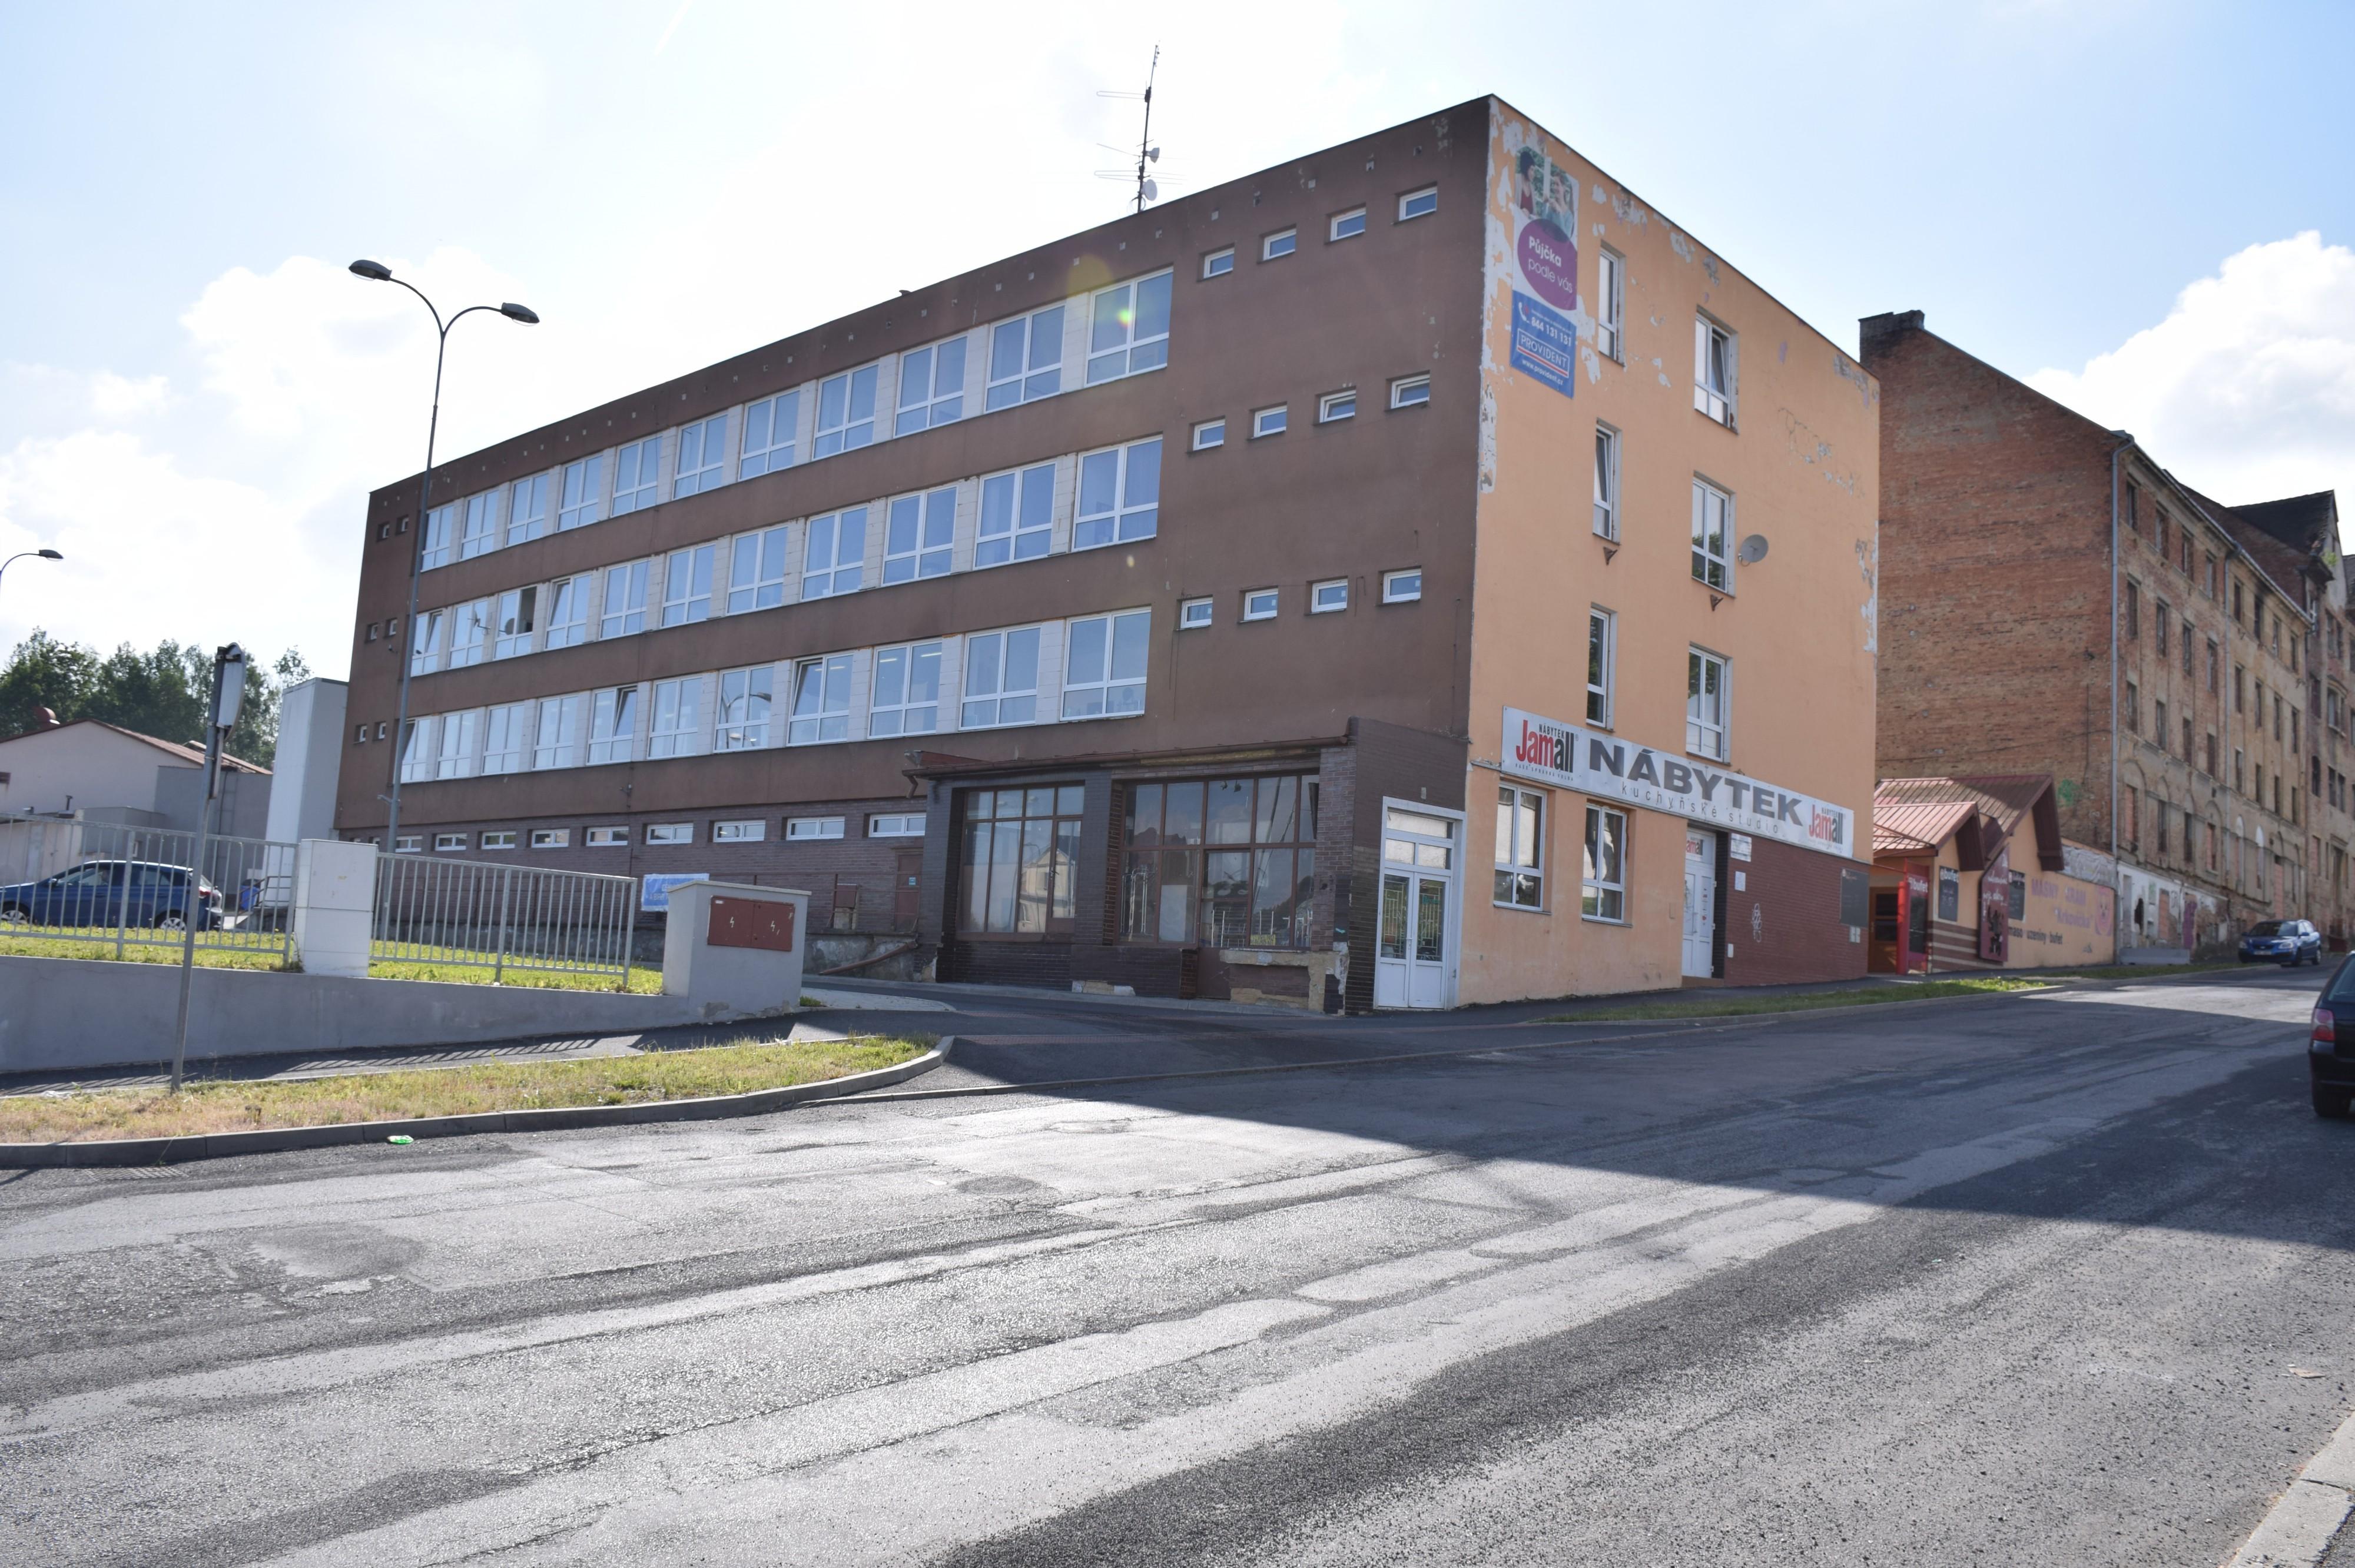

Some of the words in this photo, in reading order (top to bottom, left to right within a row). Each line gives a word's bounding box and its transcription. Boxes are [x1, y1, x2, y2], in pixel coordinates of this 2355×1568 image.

[1529, 235, 1561, 267] Půjčka
[1528, 257, 1555, 282] podle
[1557, 275, 1573, 293] vás
[1521, 334, 1567, 368] PROVIDENT
[1531, 317, 1544, 332] 844
[1546, 324, 1558, 340] 131
[1560, 333, 1571, 347] 131
[1515, 719, 1574, 773] Jamall
[1590, 738, 1803, 826] NÁBYTEK
[1622, 781, 1717, 818] kuchyňské
[1728, 810, 1779, 834] studio
[1809, 804, 1843, 845] Jamall
